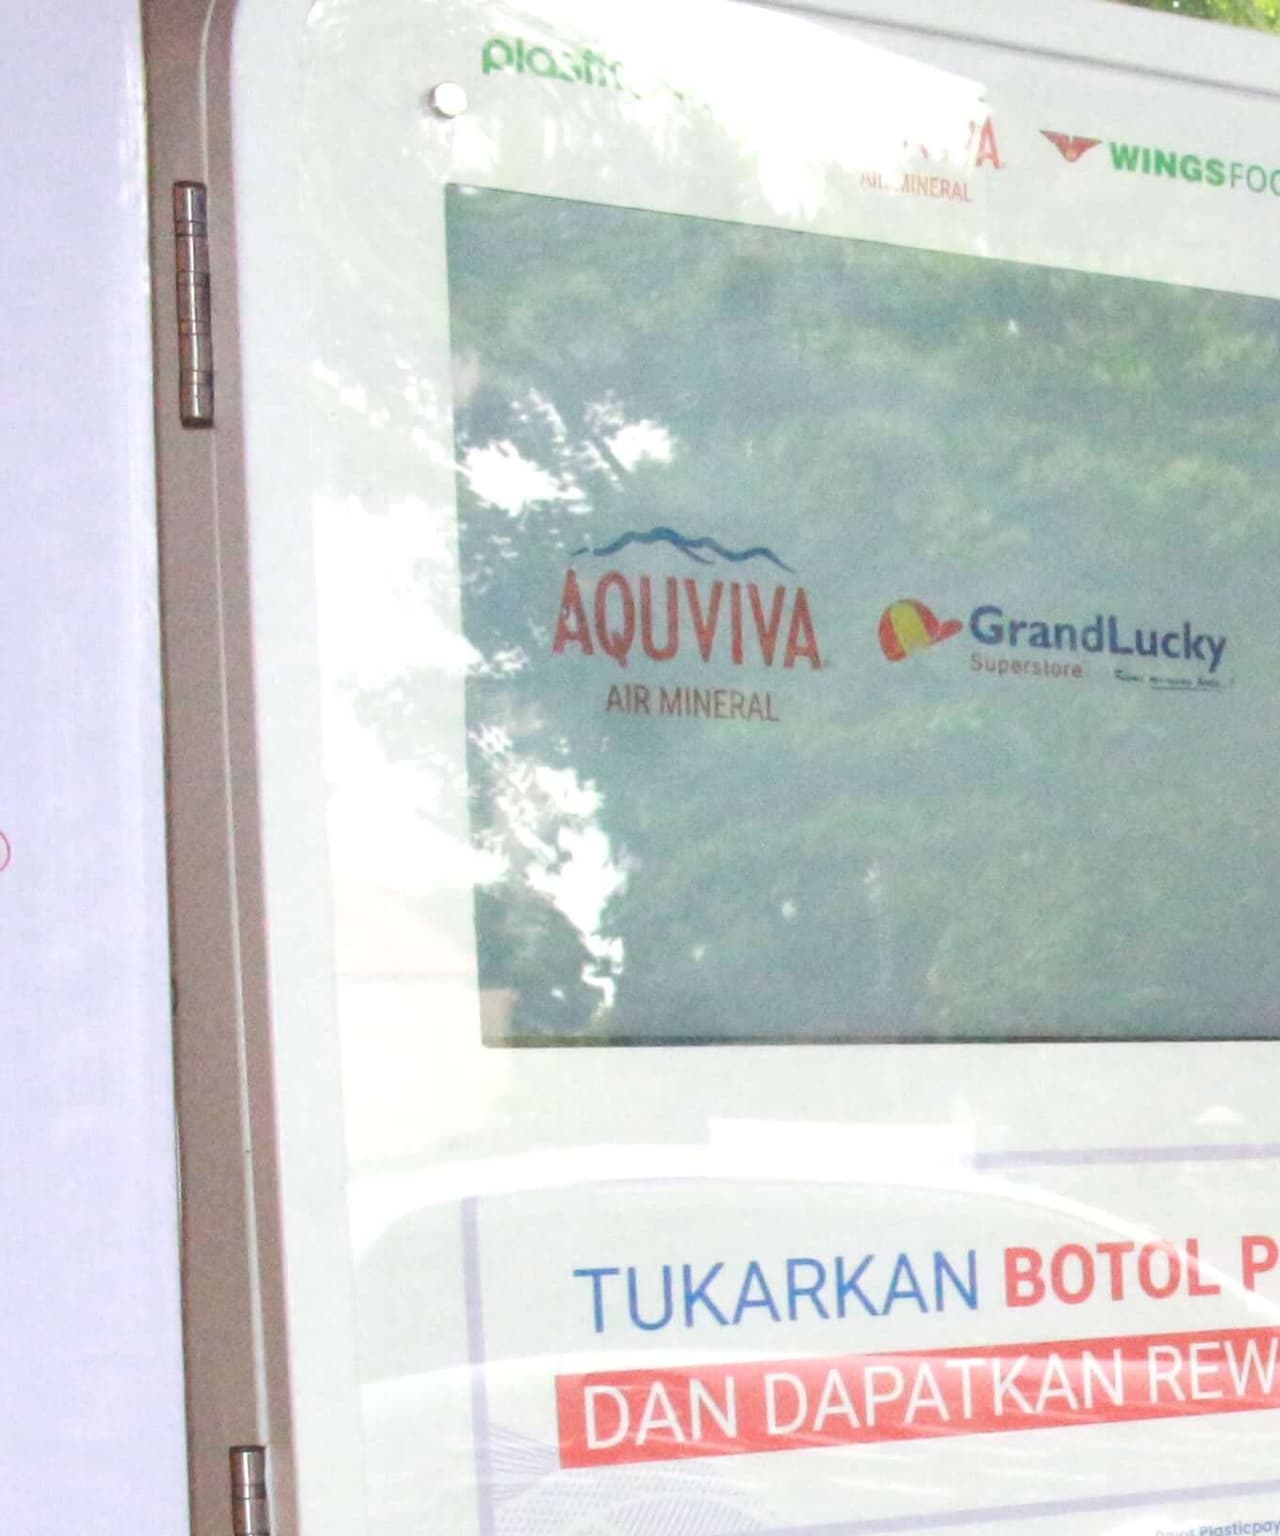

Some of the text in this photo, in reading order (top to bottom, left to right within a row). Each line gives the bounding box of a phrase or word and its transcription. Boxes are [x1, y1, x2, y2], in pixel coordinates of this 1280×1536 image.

[552, 569, 822, 670] AQUVIVA
[969, 604, 1227, 673] GrandLucky
[605, 684, 781, 722] AIR MINERAL
[970, 652, 1084, 681] Superstore
[573, 1249, 980, 1334] TUKARKAN
[1004, 1237, 1221, 1308] BOTOL
[583, 1375, 738, 1450] DAN
[764, 1349, 1124, 1437] DAPATKAN
